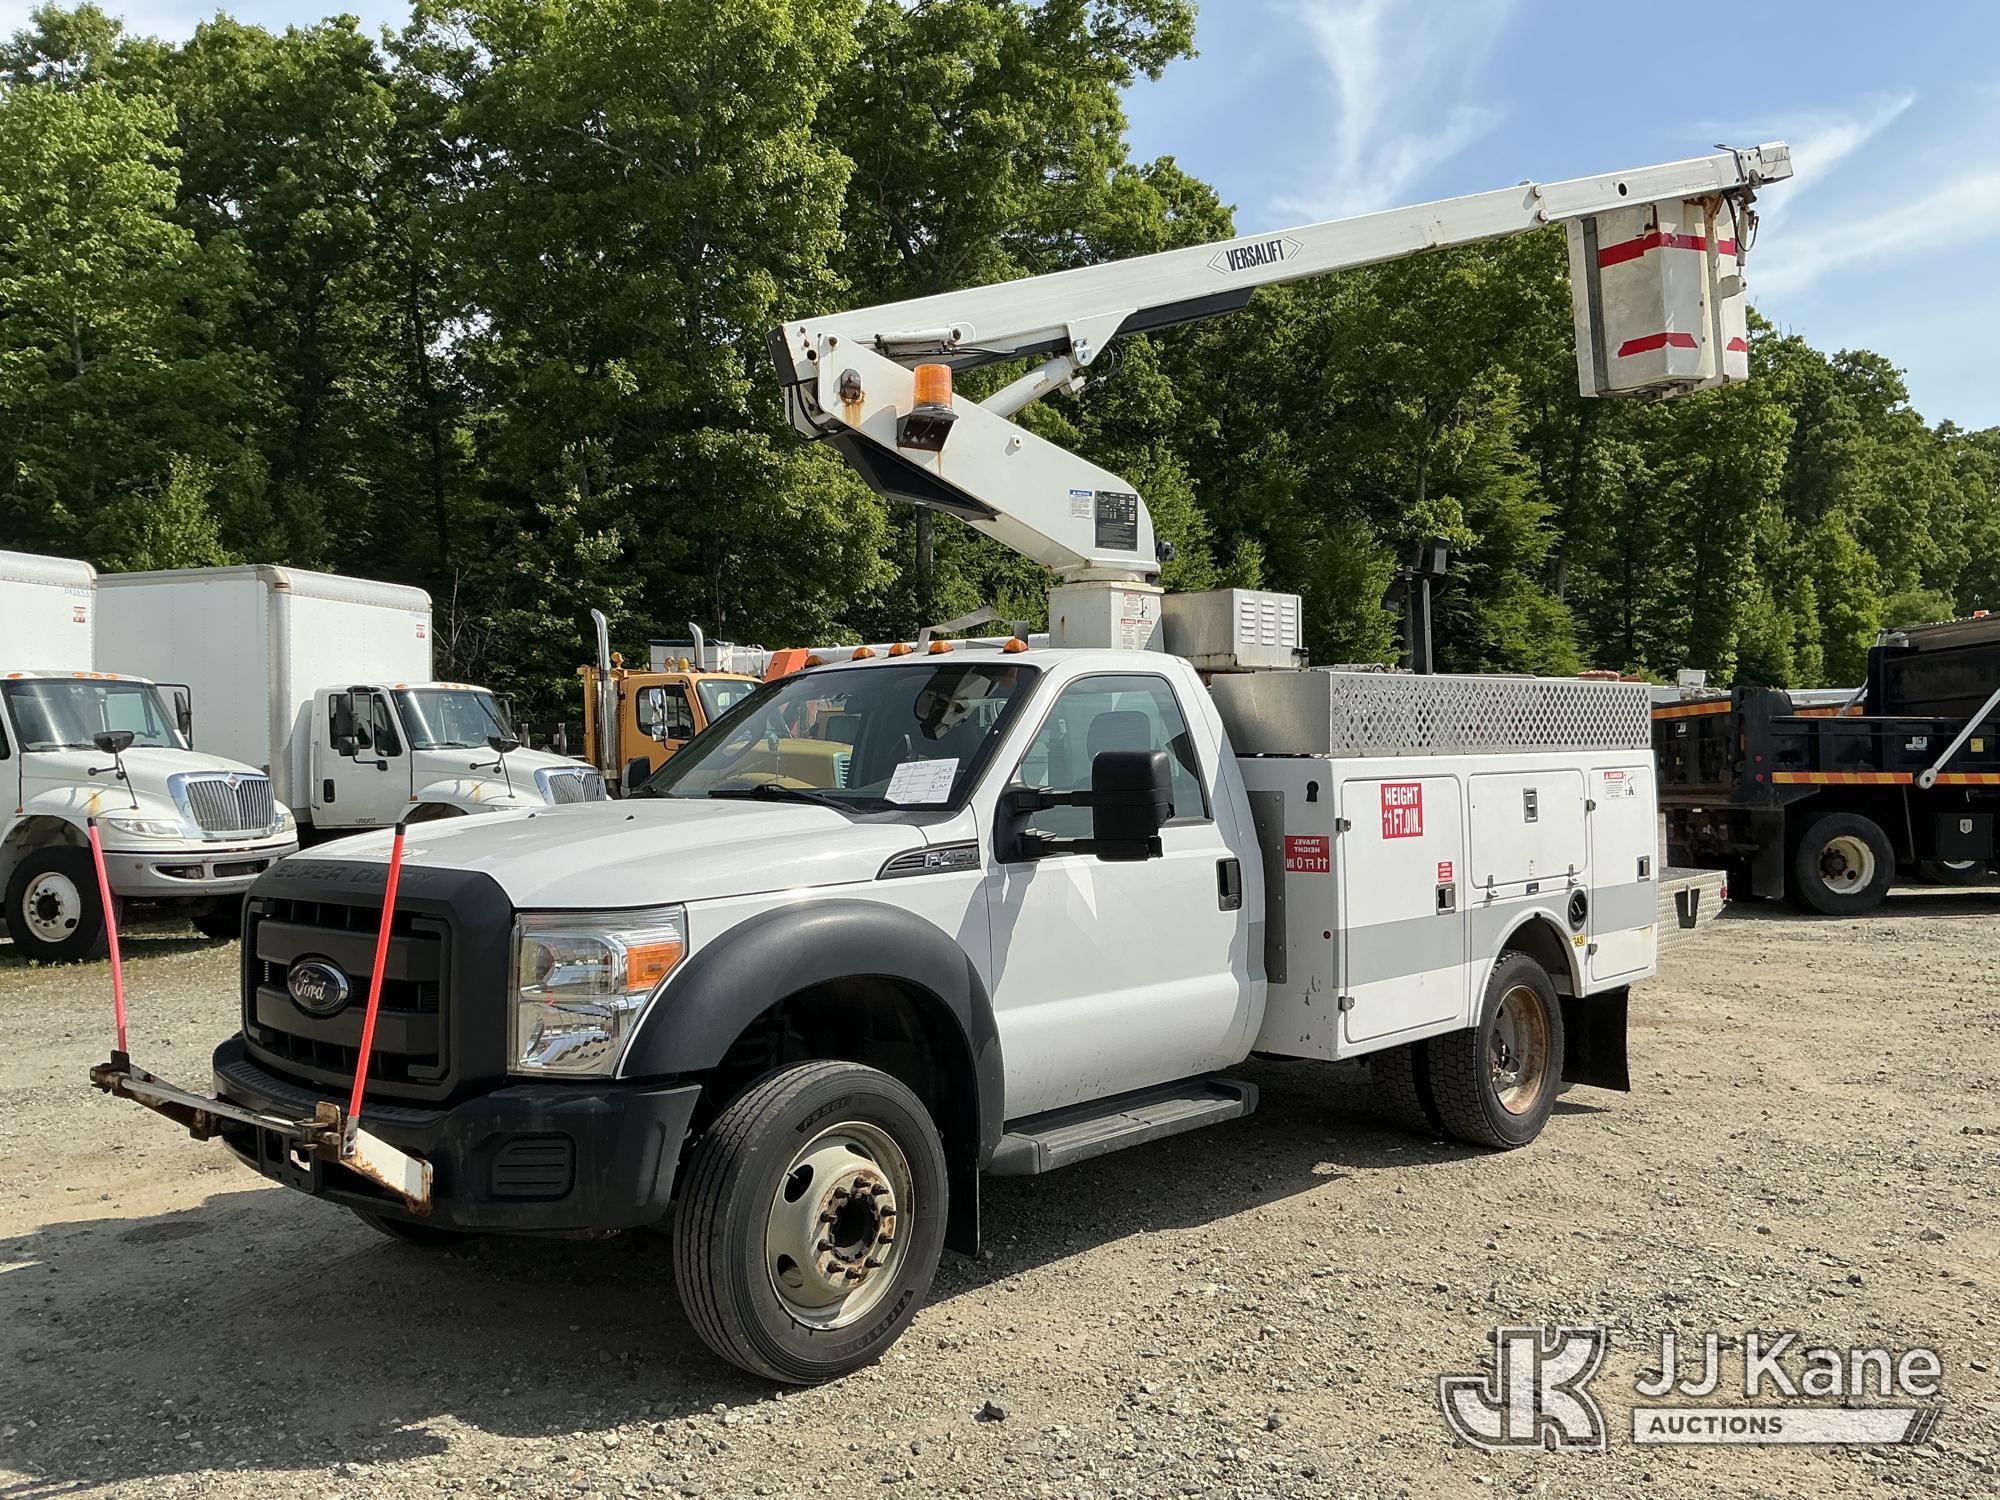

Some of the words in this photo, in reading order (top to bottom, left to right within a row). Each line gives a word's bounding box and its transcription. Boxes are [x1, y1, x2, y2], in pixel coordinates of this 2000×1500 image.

[1225, 239, 1285, 271] VERSALIFT
[1384, 786, 1419, 805] HEIGHT
[274, 864, 346, 881] SUPER
[295, 969, 327, 1000] Ford
